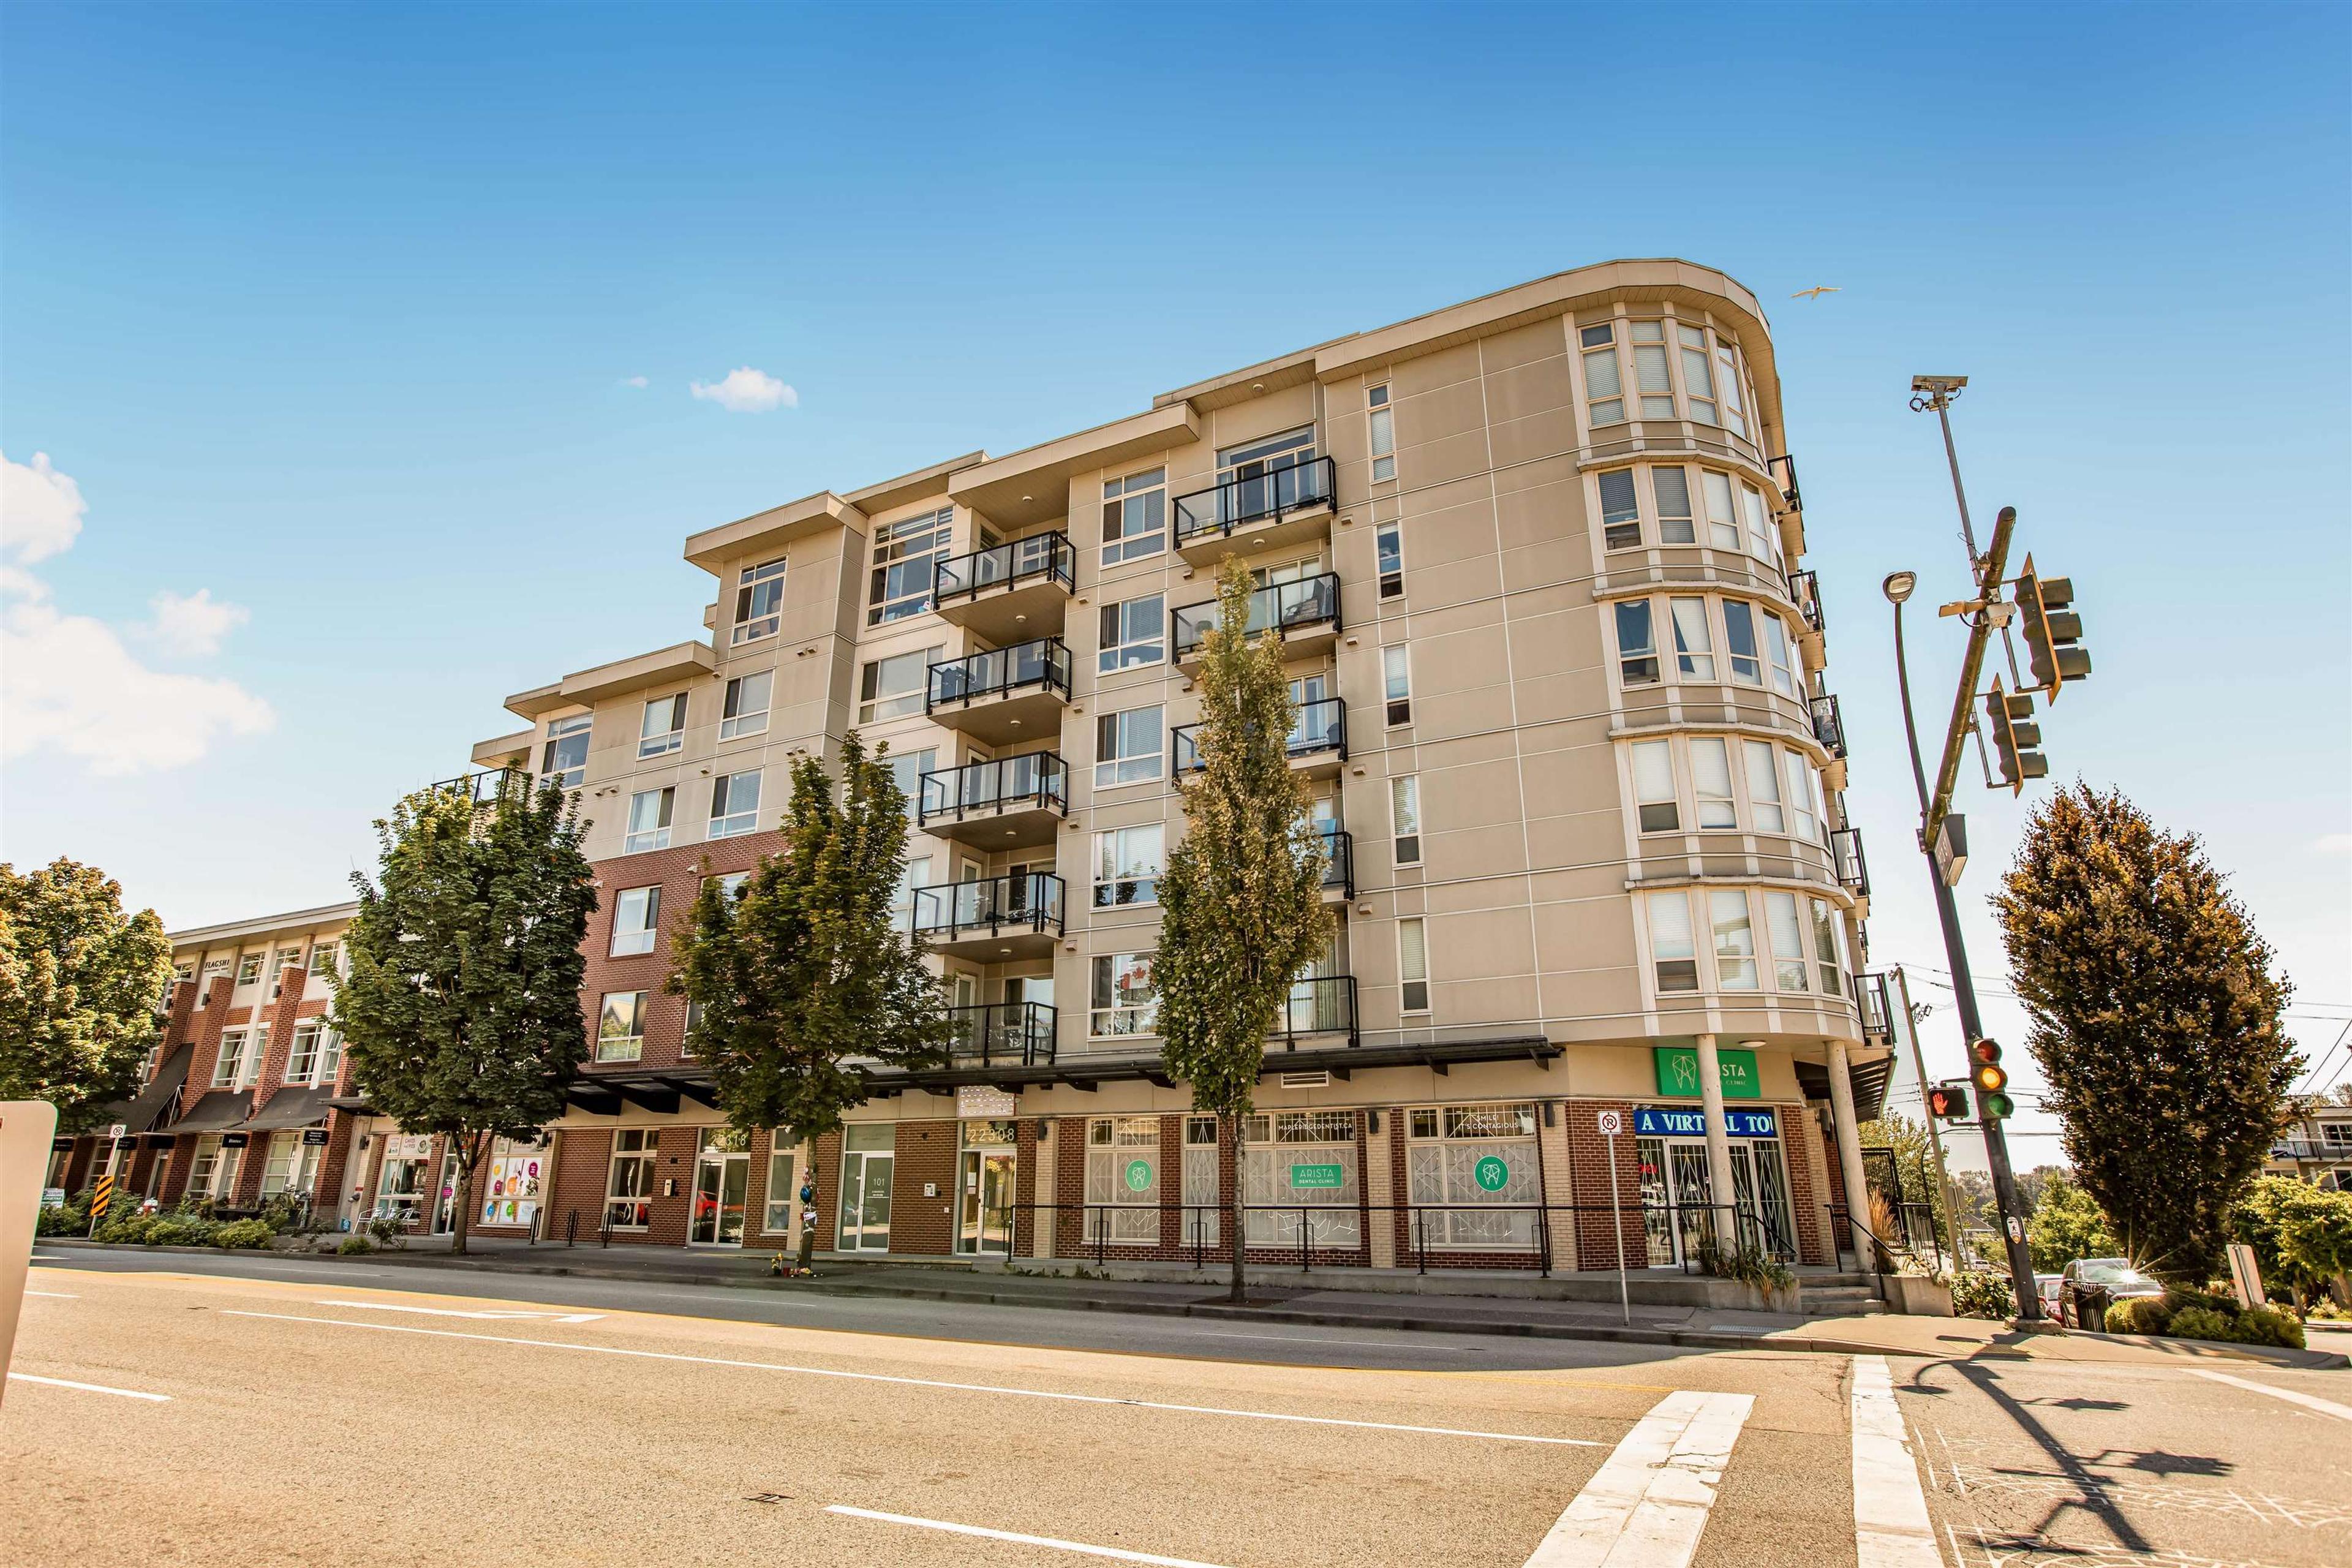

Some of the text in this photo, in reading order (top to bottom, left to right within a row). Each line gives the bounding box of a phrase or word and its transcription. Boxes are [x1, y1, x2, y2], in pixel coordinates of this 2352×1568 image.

[1722, 1064, 1746, 1077] STA
[1641, 1114, 1774, 1133] A VIRTL TO
[969, 1128, 1014, 1142] 22308
[1300, 1169, 1334, 1178] ARISTA
[873, 1177, 884, 1186] 101
